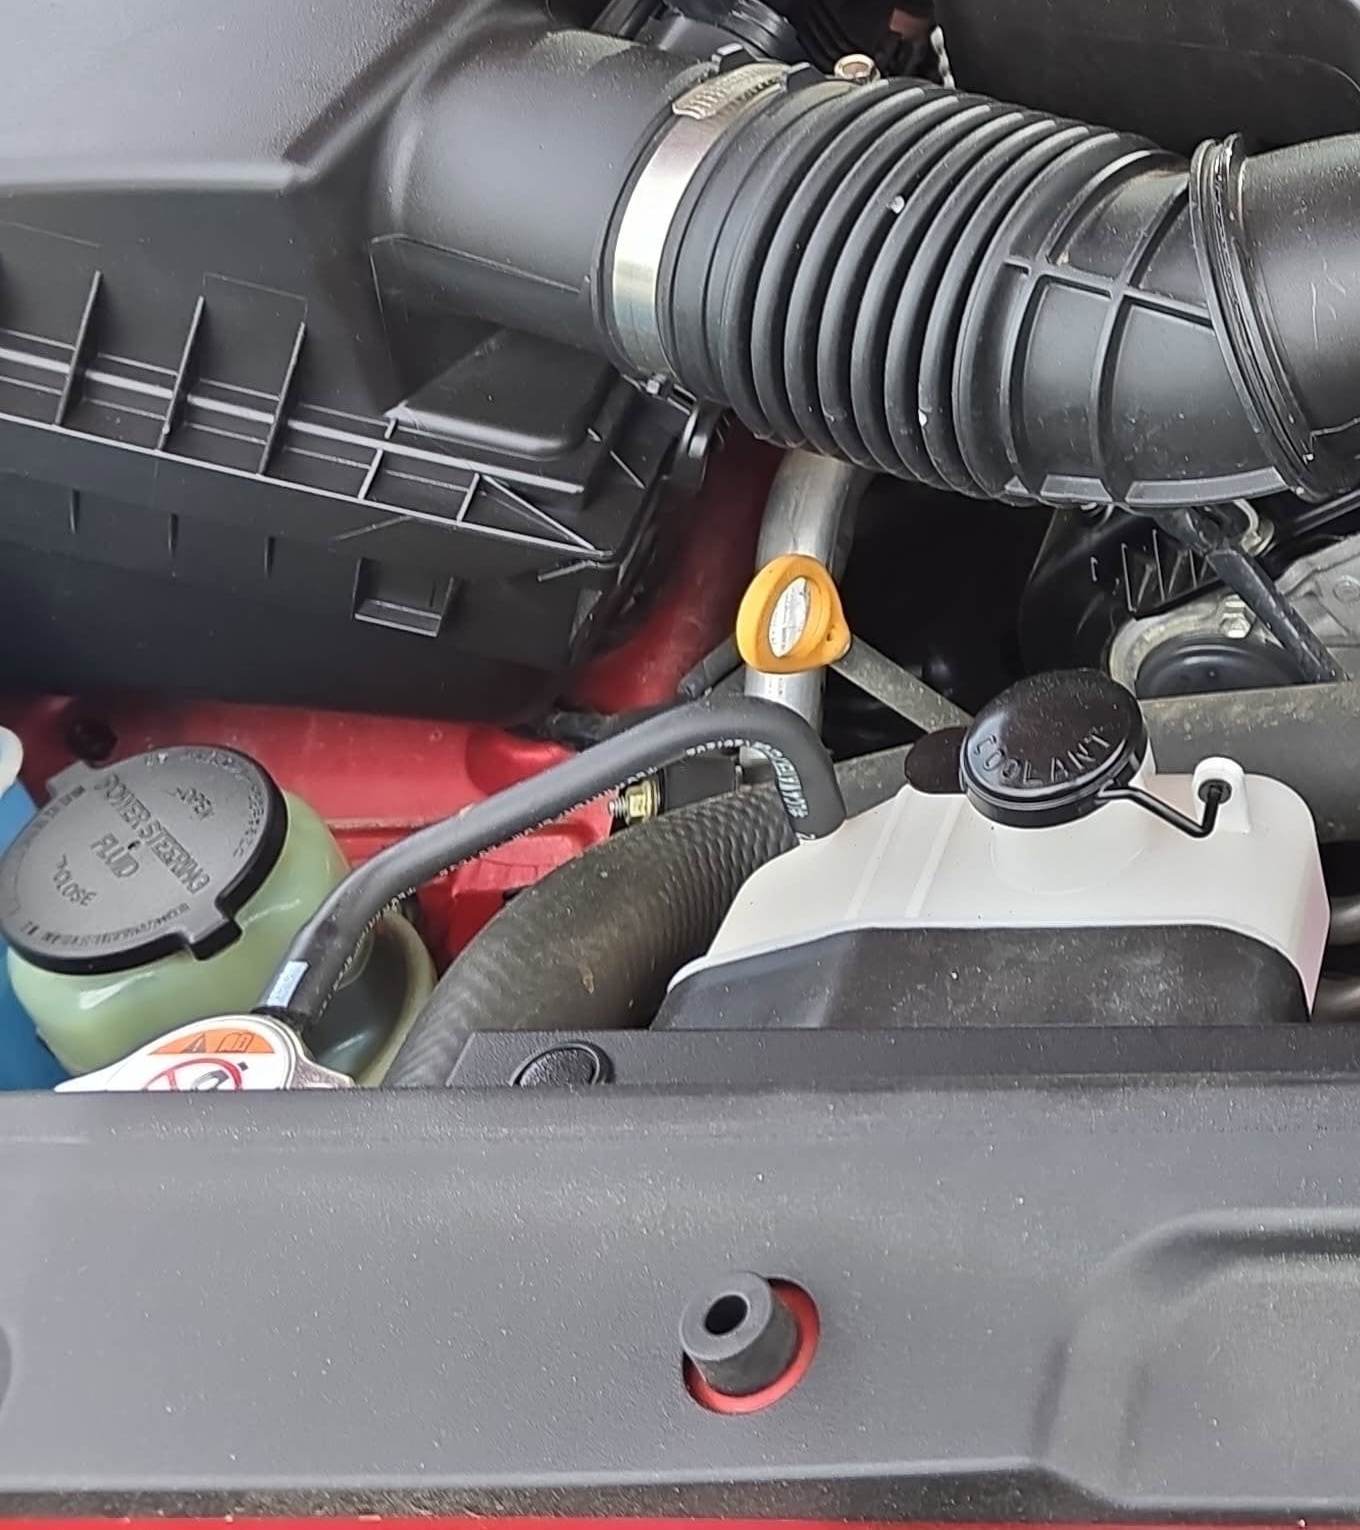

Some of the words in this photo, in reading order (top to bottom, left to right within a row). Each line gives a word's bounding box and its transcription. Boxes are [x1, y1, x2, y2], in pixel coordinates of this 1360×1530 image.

[974, 726, 1111, 786] COOLANT
[176, 786, 215, 820] OPEN
[90, 832, 139, 878] FLUID
[95, 773, 152, 830] POWER
[137, 820, 210, 894] STEERING
[52, 869, 97, 907] CLOSE
